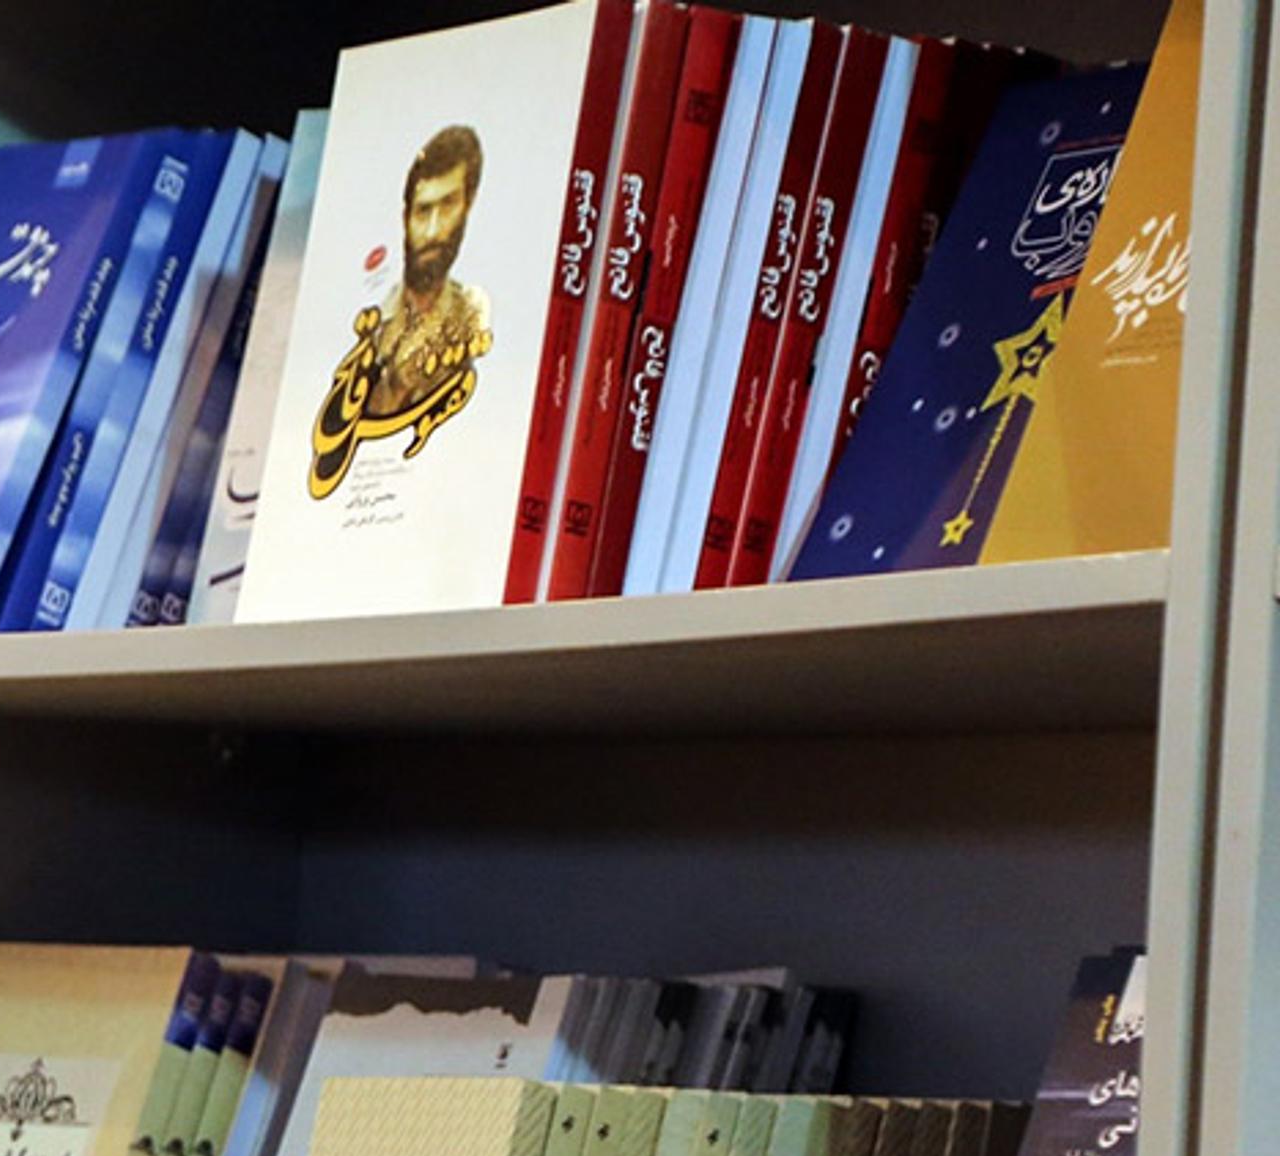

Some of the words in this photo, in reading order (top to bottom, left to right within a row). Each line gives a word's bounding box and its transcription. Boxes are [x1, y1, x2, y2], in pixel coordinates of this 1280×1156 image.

[574, 168, 598, 247] ققنوس
[622, 173, 646, 252] ققنوس
[775, 193, 796, 271] ققنوس
[812, 195, 835, 275] ققنوس
[561, 244, 586, 295] فاتح
[609, 247, 633, 300] فاتح
[760, 266, 781, 320] فاتح
[798, 268, 822, 322] فاتح
[642, 325, 666, 380] فاتح
[308, 330, 493, 500] ققنوس
[632, 368, 654, 450] ققنوس
